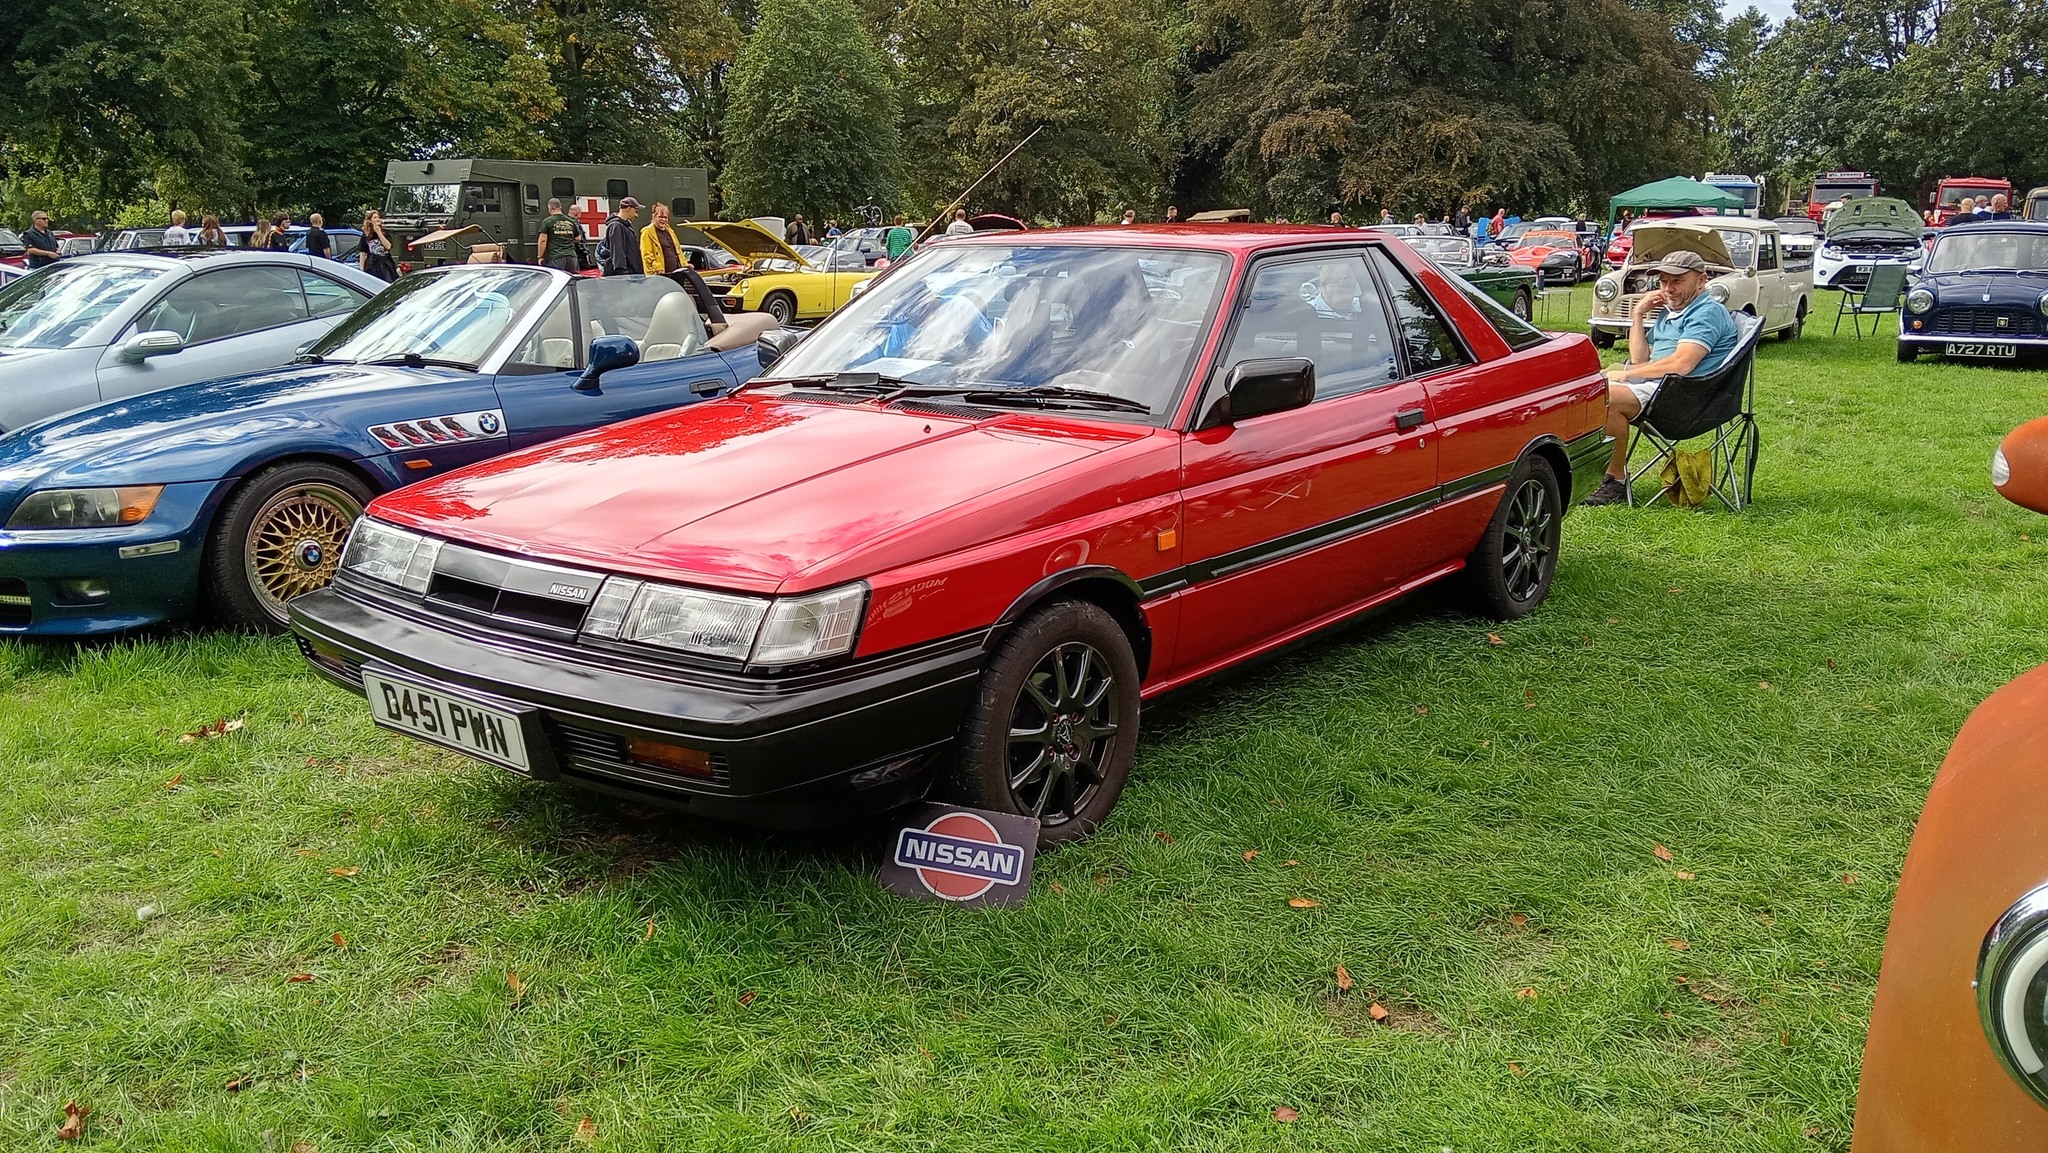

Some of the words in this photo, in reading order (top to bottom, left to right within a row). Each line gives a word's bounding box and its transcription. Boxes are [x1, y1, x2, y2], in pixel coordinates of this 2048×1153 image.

[1947, 343, 1984, 355] A727
[1986, 345, 2015, 356] RTU
[550, 583, 588, 599] NISSAN
[379, 682, 447, 737] D451
[448, 702, 510, 758] PWN
[905, 838, 1015, 875] NISSAN
